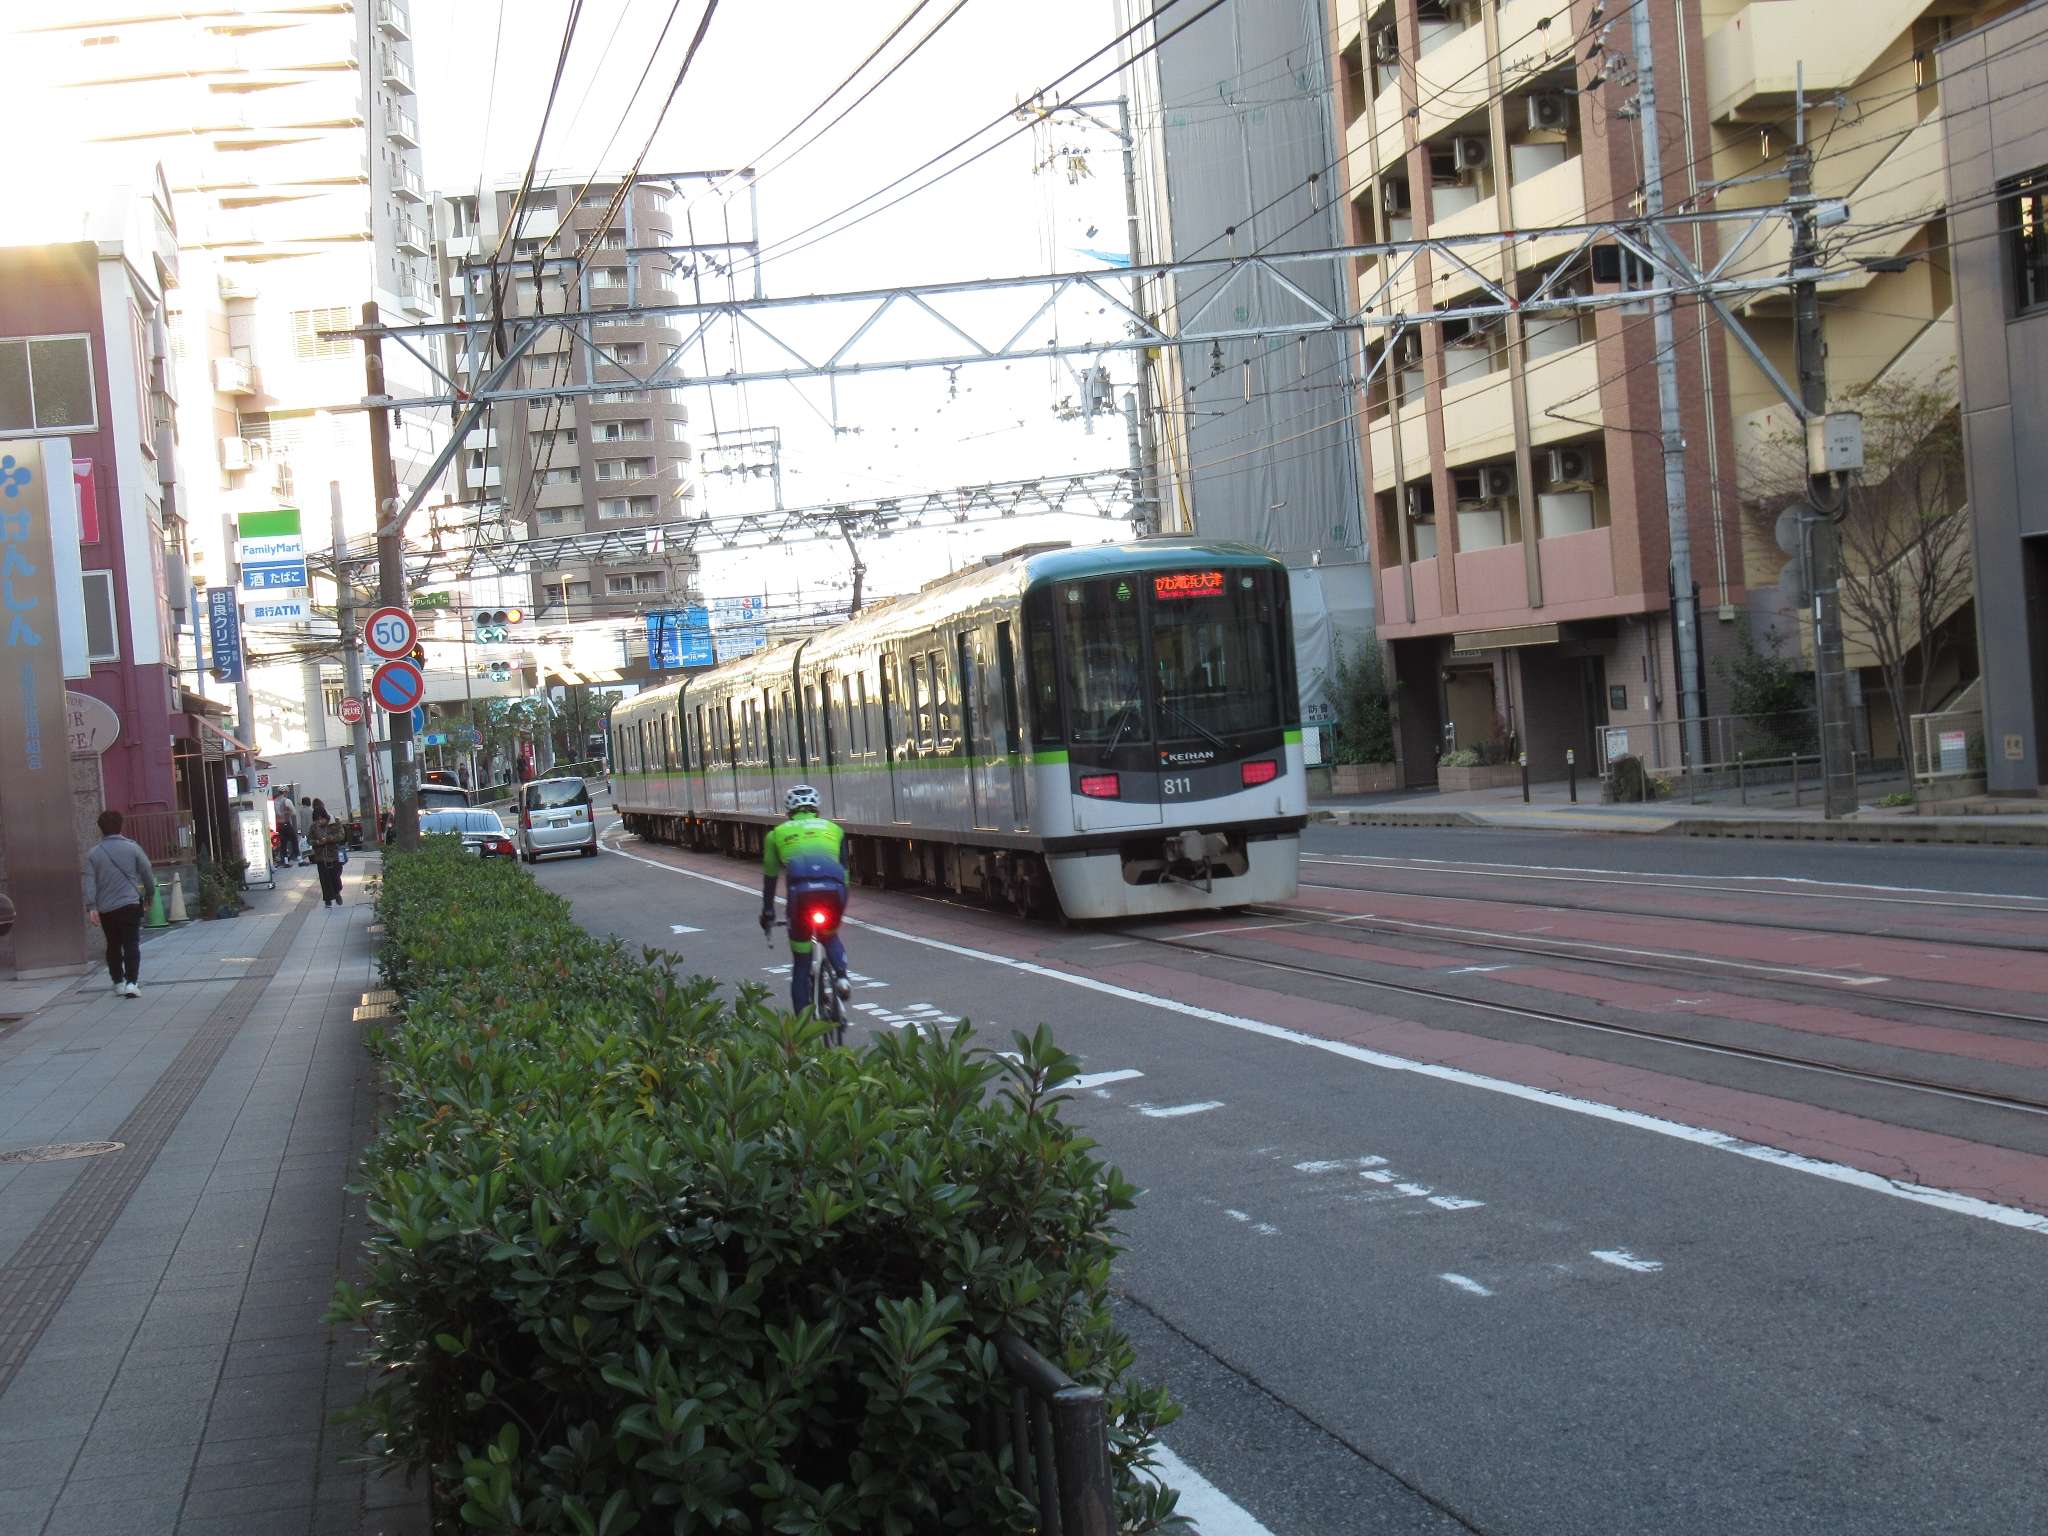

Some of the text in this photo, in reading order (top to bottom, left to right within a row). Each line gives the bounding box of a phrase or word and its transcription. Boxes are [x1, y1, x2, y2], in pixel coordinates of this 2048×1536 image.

[242, 543, 301, 556] FamilyMart
[250, 571, 300, 586] 酒 たばこ
[255, 604, 301, 617] 銀行ATM
[212, 592, 232, 680] 由良クリニック
[375, 621, 406, 645] 50
[1169, 751, 1215, 761] KEIHAN
[1164, 777, 1191, 795] 811
